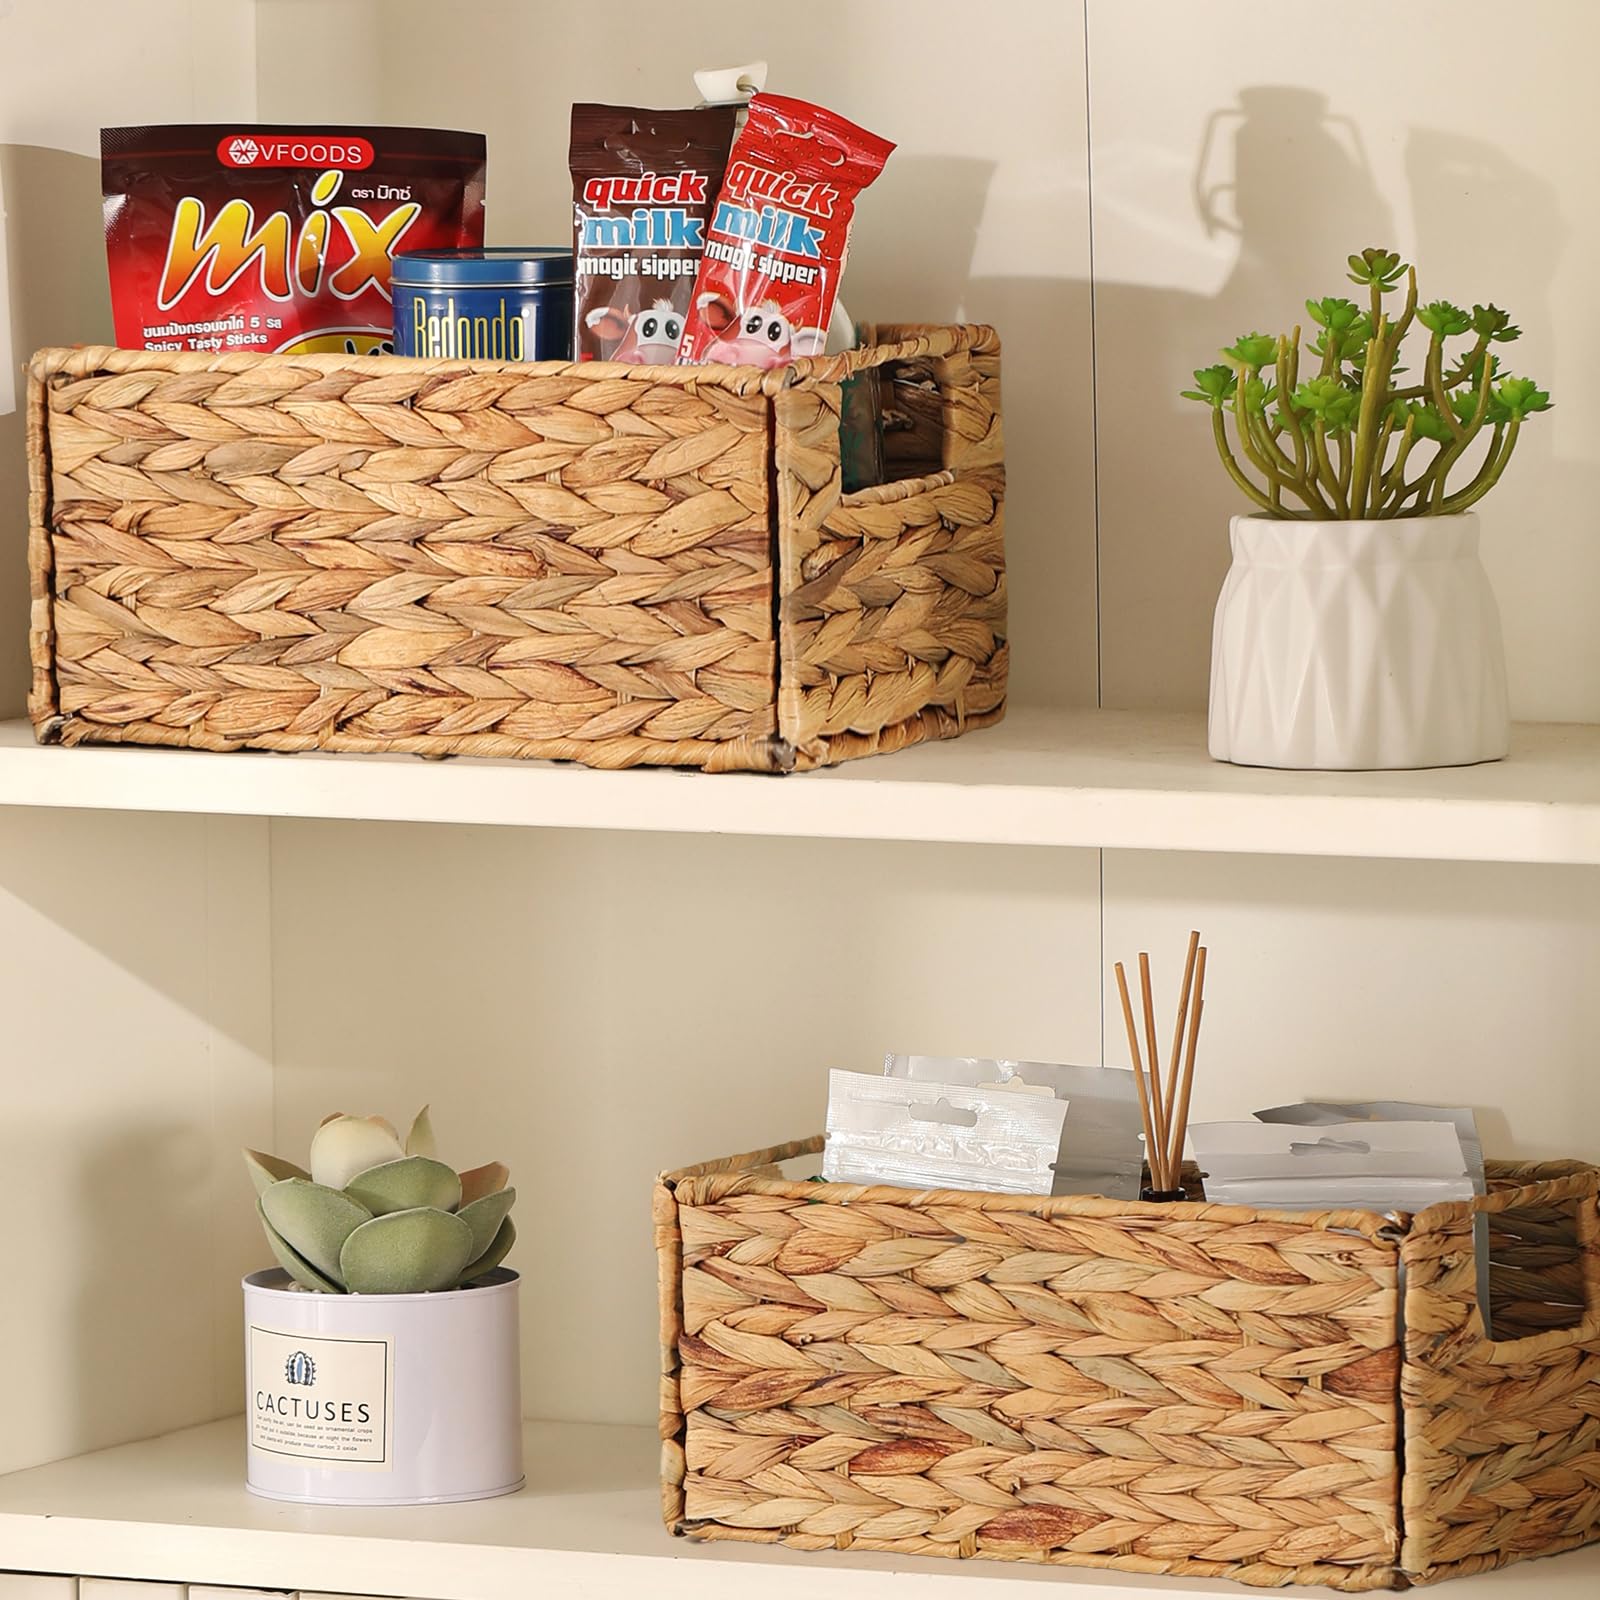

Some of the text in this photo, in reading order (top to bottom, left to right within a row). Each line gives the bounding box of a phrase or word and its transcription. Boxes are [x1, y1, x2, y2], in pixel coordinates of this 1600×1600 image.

[259, 144, 362, 164] VFOODS
[351, 184, 412, 201] ตรา มิกซ์
[583, 170, 708, 212] quick
[727, 160, 840, 219] quick
[157, 169, 421, 312] mix
[582, 208, 705, 249] milk
[712, 200, 826, 259] milk
[580, 253, 701, 280] magic sipper
[758, 252, 818, 285] sipper
[250, 316, 261, 329] 5
[266, 317, 283, 330] รส
[413, 296, 524, 361] Redondo
[144, 332, 268, 351] Spicy Tasty Sticks
[681, 333, 695, 358] 5
[256, 1390, 370, 1423] CACTUSES
